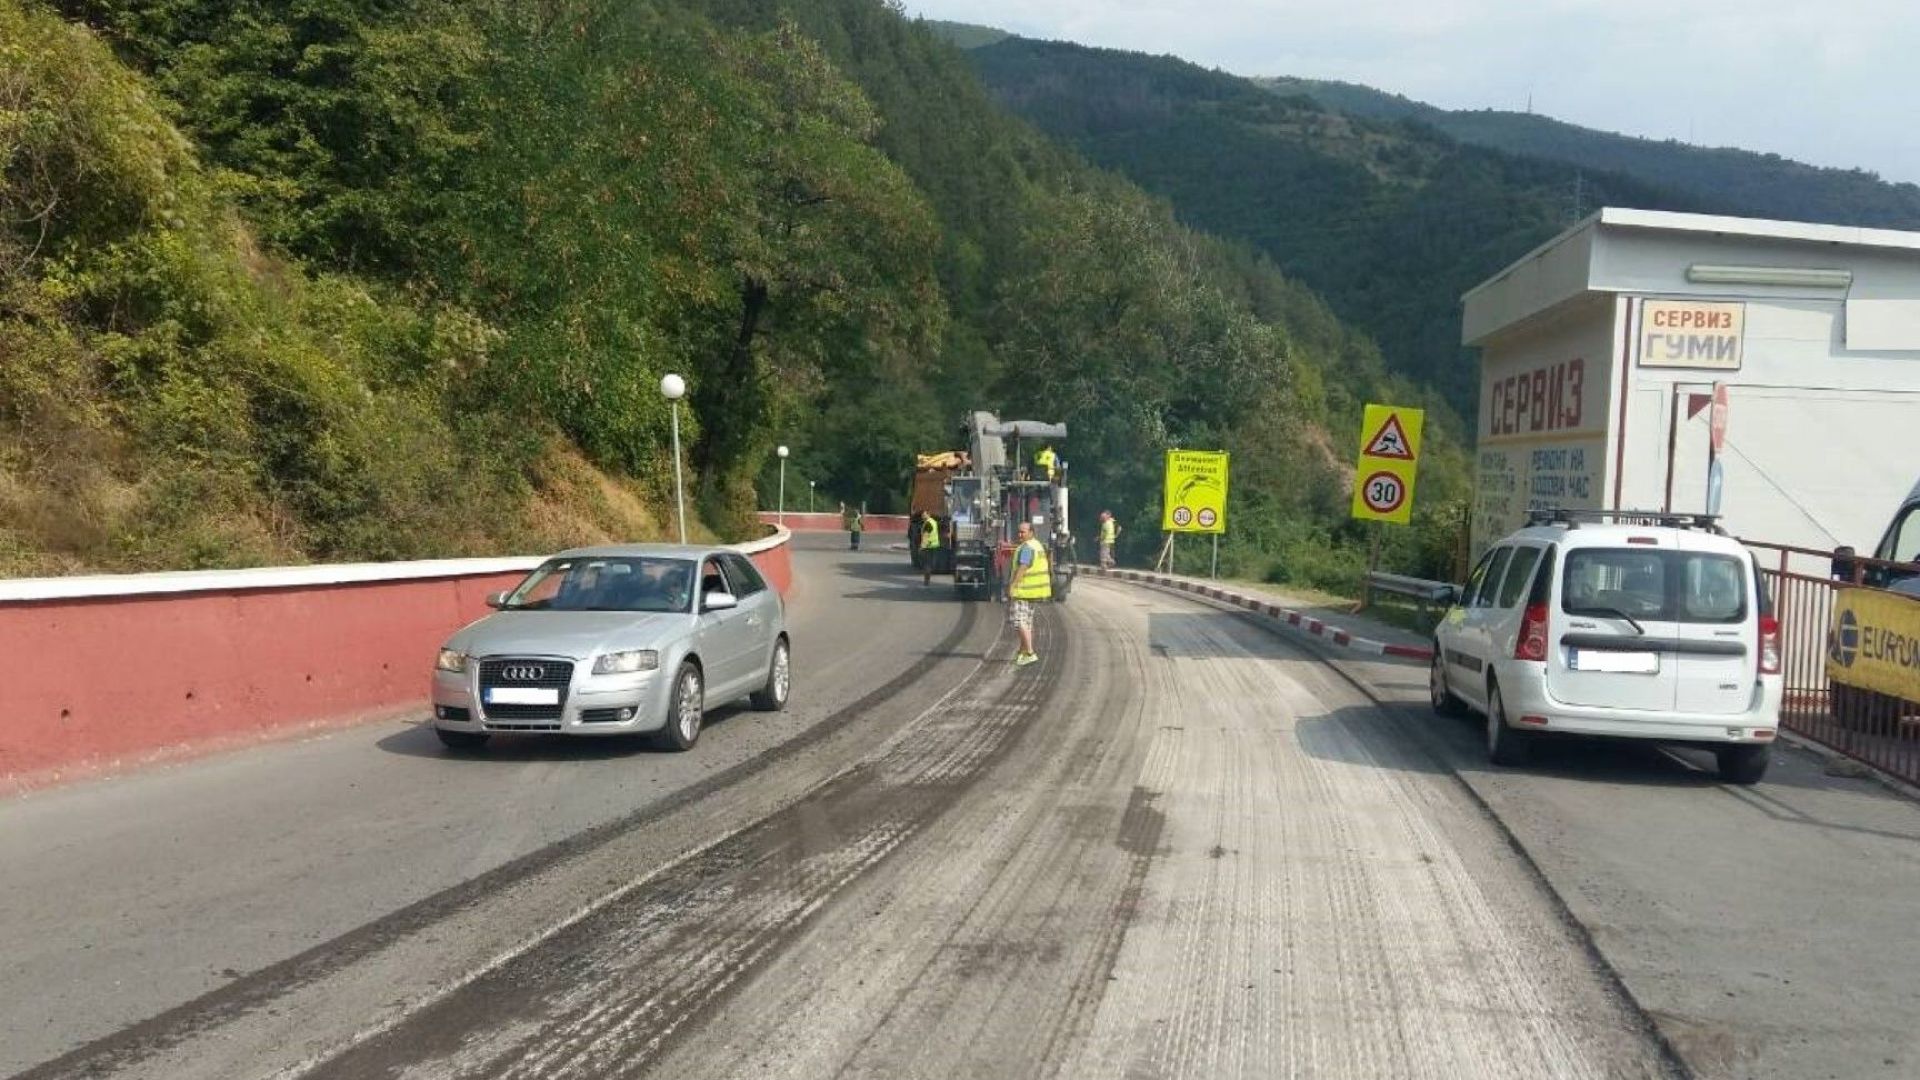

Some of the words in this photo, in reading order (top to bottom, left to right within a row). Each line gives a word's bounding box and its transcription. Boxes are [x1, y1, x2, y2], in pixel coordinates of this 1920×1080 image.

[1654, 309, 1732, 329] СЕРВИЗ
[1646, 332, 1737, 361] ГУМИ
[1490, 358, 1584, 435] СЕРВИЗ
[1372, 482, 1396, 503] 30
[1176, 511, 1189, 522] 30
